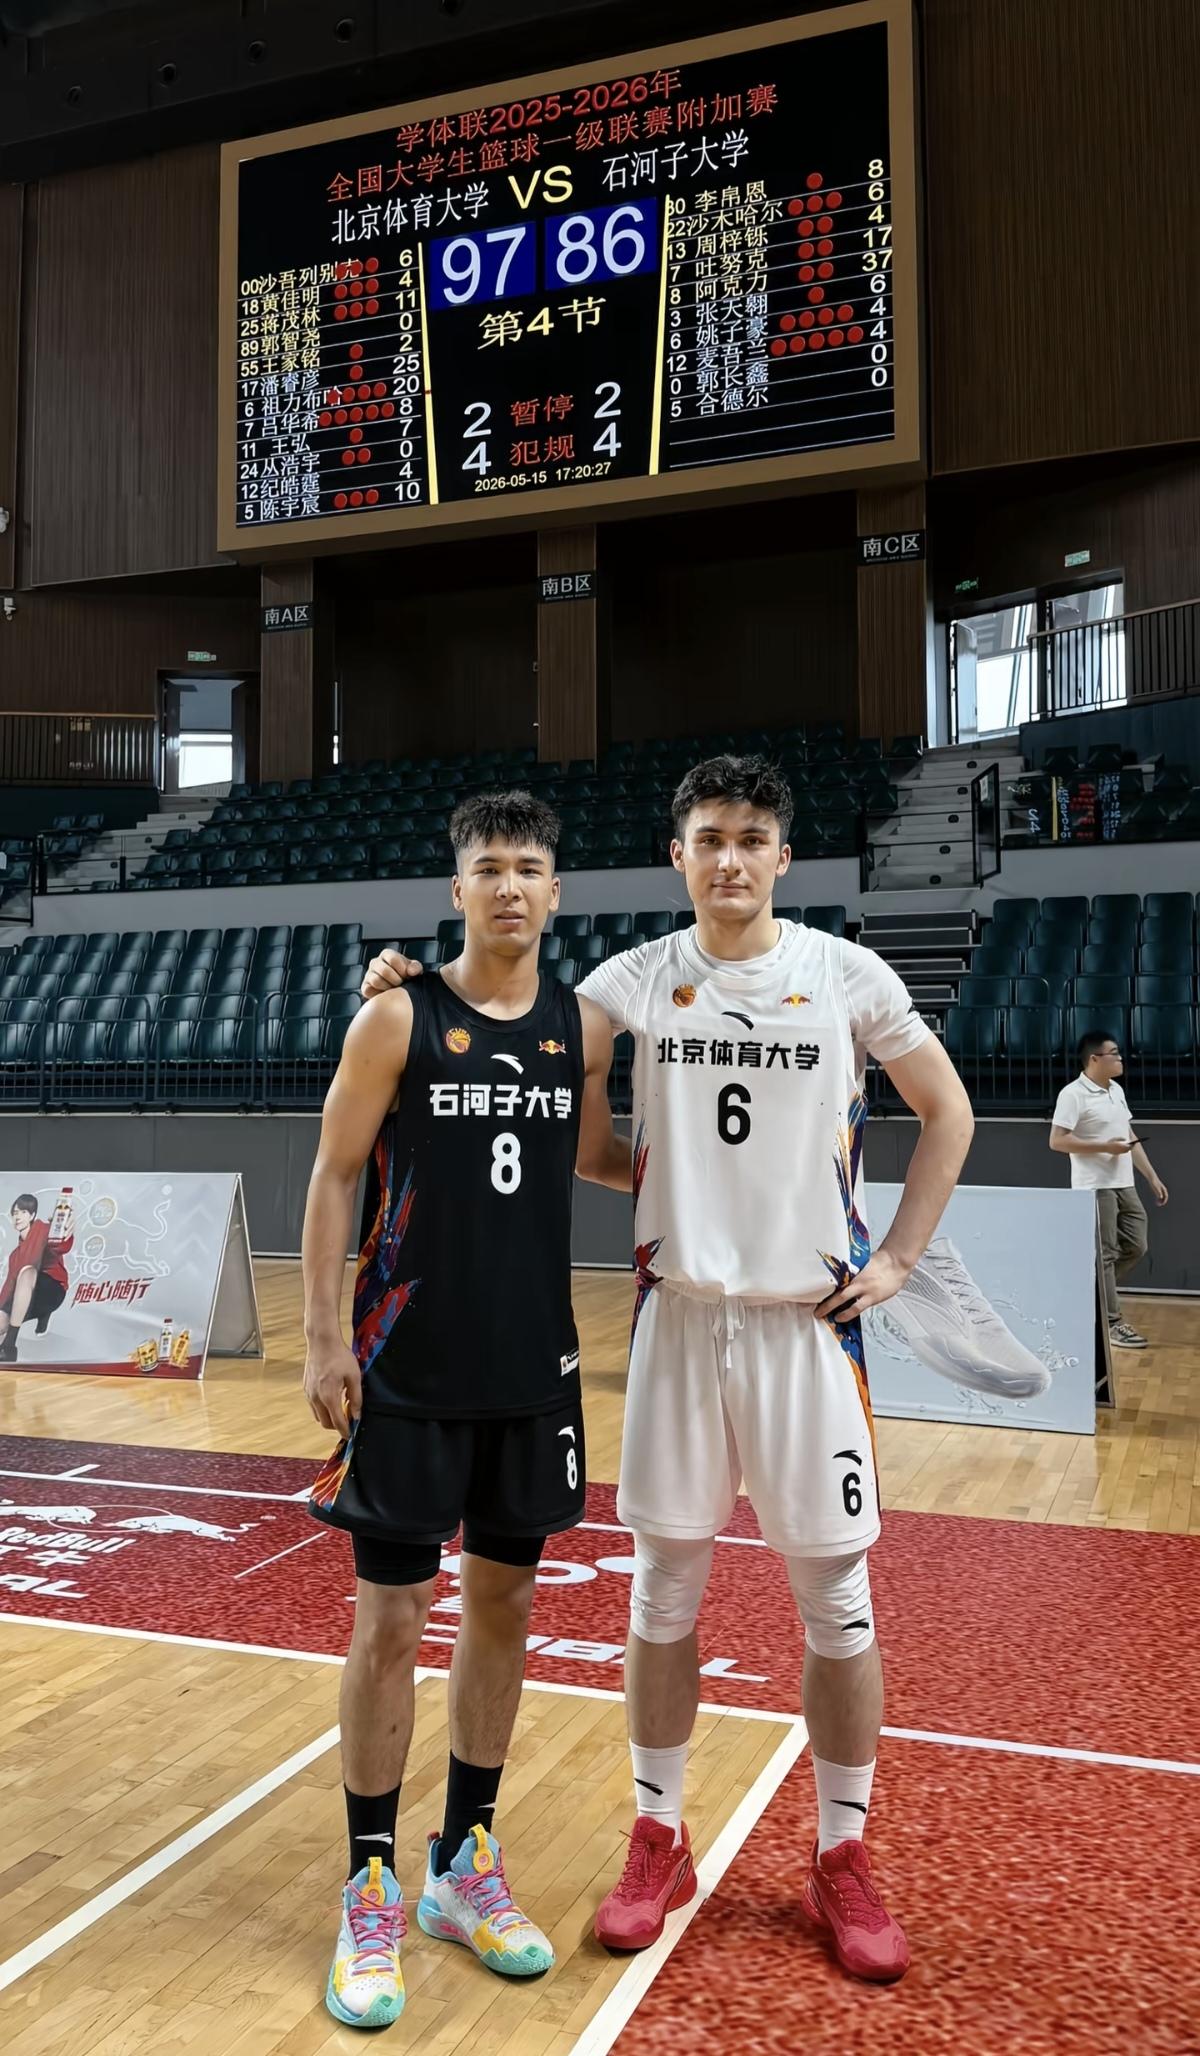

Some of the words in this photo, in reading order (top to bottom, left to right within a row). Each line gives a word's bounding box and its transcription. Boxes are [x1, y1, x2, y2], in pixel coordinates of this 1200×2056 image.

[396, 69, 682, 153] 学体联2025-2026年
[326, 83, 778, 203] 全国大学生篮球一级联赛附加赛
[331, 181, 489, 245] 北京体育大学
[508, 165, 574, 209] VS
[602, 128, 749, 192] 石河子大学
[695, 180, 767, 212] 李帛恩
[868, 159, 884, 179] 8
[686, 201, 783, 236] 沙木哈尔
[868, 182, 884, 201] 6
[695, 224, 769, 258] 周梓铄
[868, 204, 885, 224] 4
[241, 278, 259, 296] 00
[400, 249, 413, 267] 6
[442, 226, 526, 304] 97
[556, 206, 645, 283] 86
[670, 265, 681, 283] 7
[695, 248, 768, 279] 吐努克
[863, 226, 893, 249] 17
[670, 288, 681, 305] 8
[696, 270, 768, 304] 阿克力
[862, 249, 893, 272] 37
[240, 319, 259, 336] 25
[260, 305, 321, 335] 蒋茂林
[395, 291, 415, 310] 11
[241, 299, 259, 316] 18
[260, 285, 320, 315] 黄佳明
[399, 270, 413, 287] 4
[670, 310, 681, 327] 3
[870, 274, 886, 293] 6
[240, 339, 259, 357] 89
[261, 328, 320, 355] 郭智尧
[399, 312, 413, 330] 0
[477, 296, 606, 350] 第4节
[667, 355, 686, 372] 12
[695, 338, 769, 372] 麦吾兰
[870, 320, 887, 339] 4
[670, 333, 681, 350] 6
[695, 315, 769, 349] 姚子豪
[870, 296, 886, 316] 4
[240, 360, 259, 377] 55
[260, 348, 320, 375] 王家铭
[399, 334, 413, 352] 2
[241, 381, 259, 397] 17
[260, 369, 320, 396] 潘睿彦
[393, 354, 420, 375] 25
[670, 378, 681, 395] 0
[696, 361, 769, 393] 郭长鑫
[871, 343, 887, 363] 0
[245, 402, 254, 417] 6
[393, 375, 420, 395] 20
[463, 402, 492, 438] 2
[510, 393, 574, 427] 暂停
[594, 381, 621, 419] 2
[670, 400, 681, 417] 5
[695, 386, 769, 415] 合德尔
[871, 367, 888, 387] 0
[241, 442, 256, 458] 11
[270, 433, 310, 457] 王弘
[400, 419, 413, 437] 7
[245, 423, 254, 437] 7
[262, 410, 320, 437] 吕华希
[400, 397, 413, 415] 8
[240, 464, 258, 479] 24
[260, 452, 320, 478] 丛浩宇
[400, 440, 413, 458] 0
[462, 441, 492, 475] 4
[509, 434, 575, 466] 犯规
[593, 422, 622, 457] 4
[241, 484, 258, 499] 12
[399, 462, 413, 479] 4
[475, 472, 547, 492] 2026-05-15
[556, 462, 611, 481] 17:20:27
[245, 505, 254, 520] 5
[260, 494, 320, 521] 陈宇宸
[395, 482, 420, 501] 10
[863, 533, 920, 557] 南C区
[542, 574, 592, 597] 南B区
[264, 605, 309, 626] 南A区
[658, 1037, 820, 1070] 北京体育大学
[429, 1083, 572, 1119] 石河子大学
[718, 1083, 751, 1145] 6
[490, 1132, 522, 1195] 8
[71, 1277, 154, 1308] 随心随行
[566, 1448, 578, 1490] 8
[842, 1472, 863, 1517] 6
